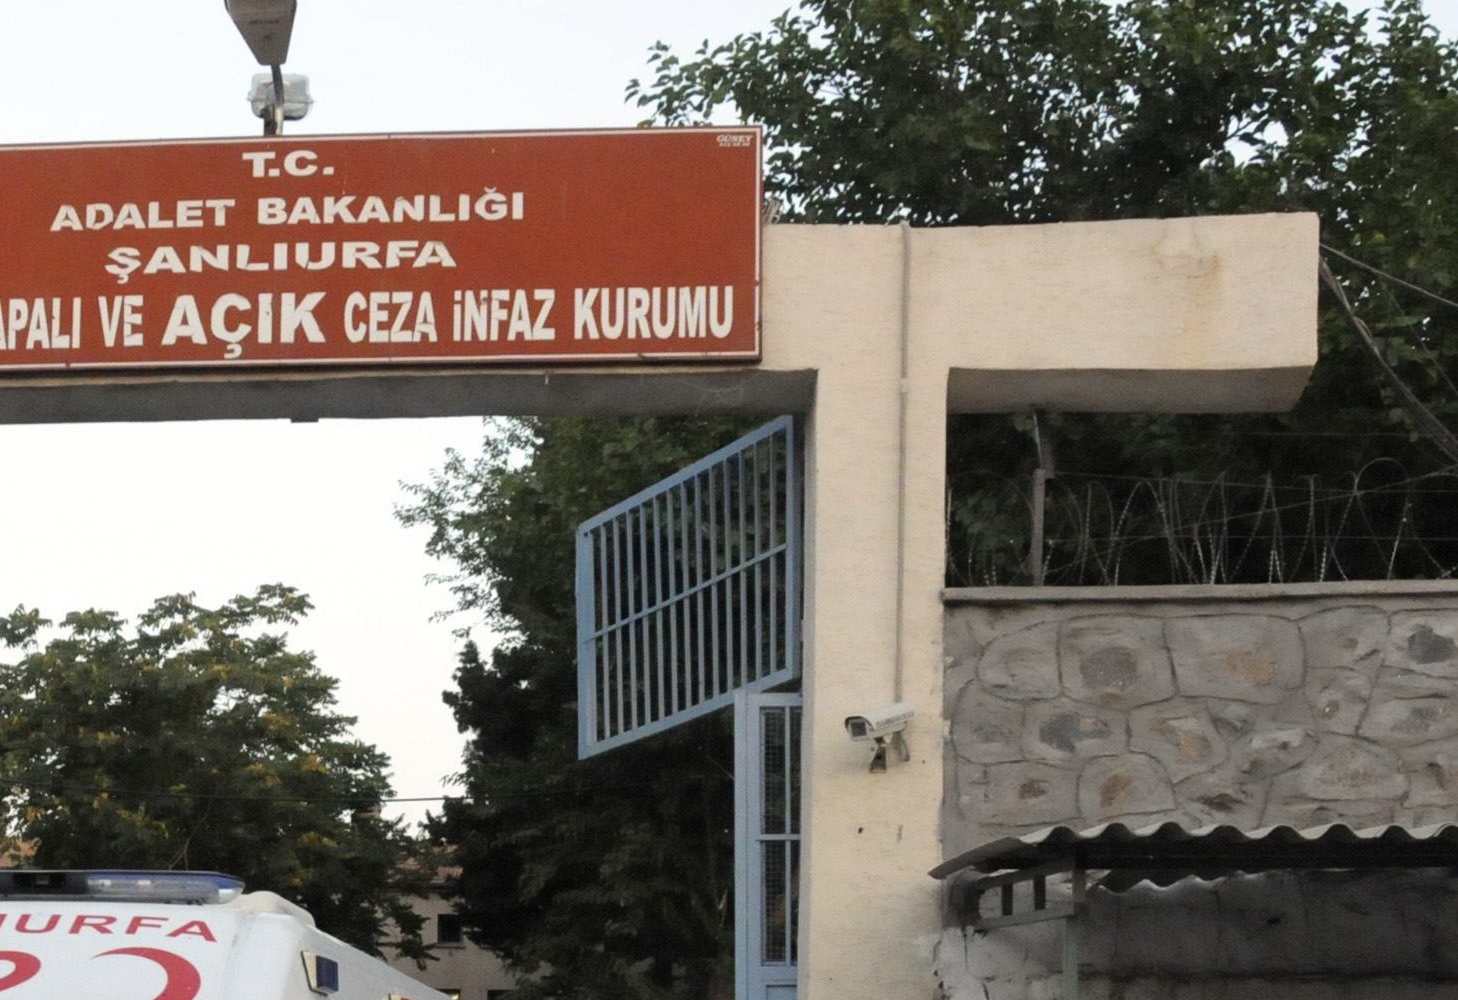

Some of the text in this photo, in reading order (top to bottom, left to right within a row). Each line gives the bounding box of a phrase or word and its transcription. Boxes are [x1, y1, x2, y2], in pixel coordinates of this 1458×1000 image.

[242, 149, 335, 178] T.C.
[50, 186, 525, 231] ADALET BAKANLIĞI
[104, 240, 457, 284] ŞANLIURFA
[98, 295, 144, 347] VE
[160, 291, 326, 359] AÇIK
[344, 291, 438, 343] CEZA
[574, 286, 733, 339] KURUMU
